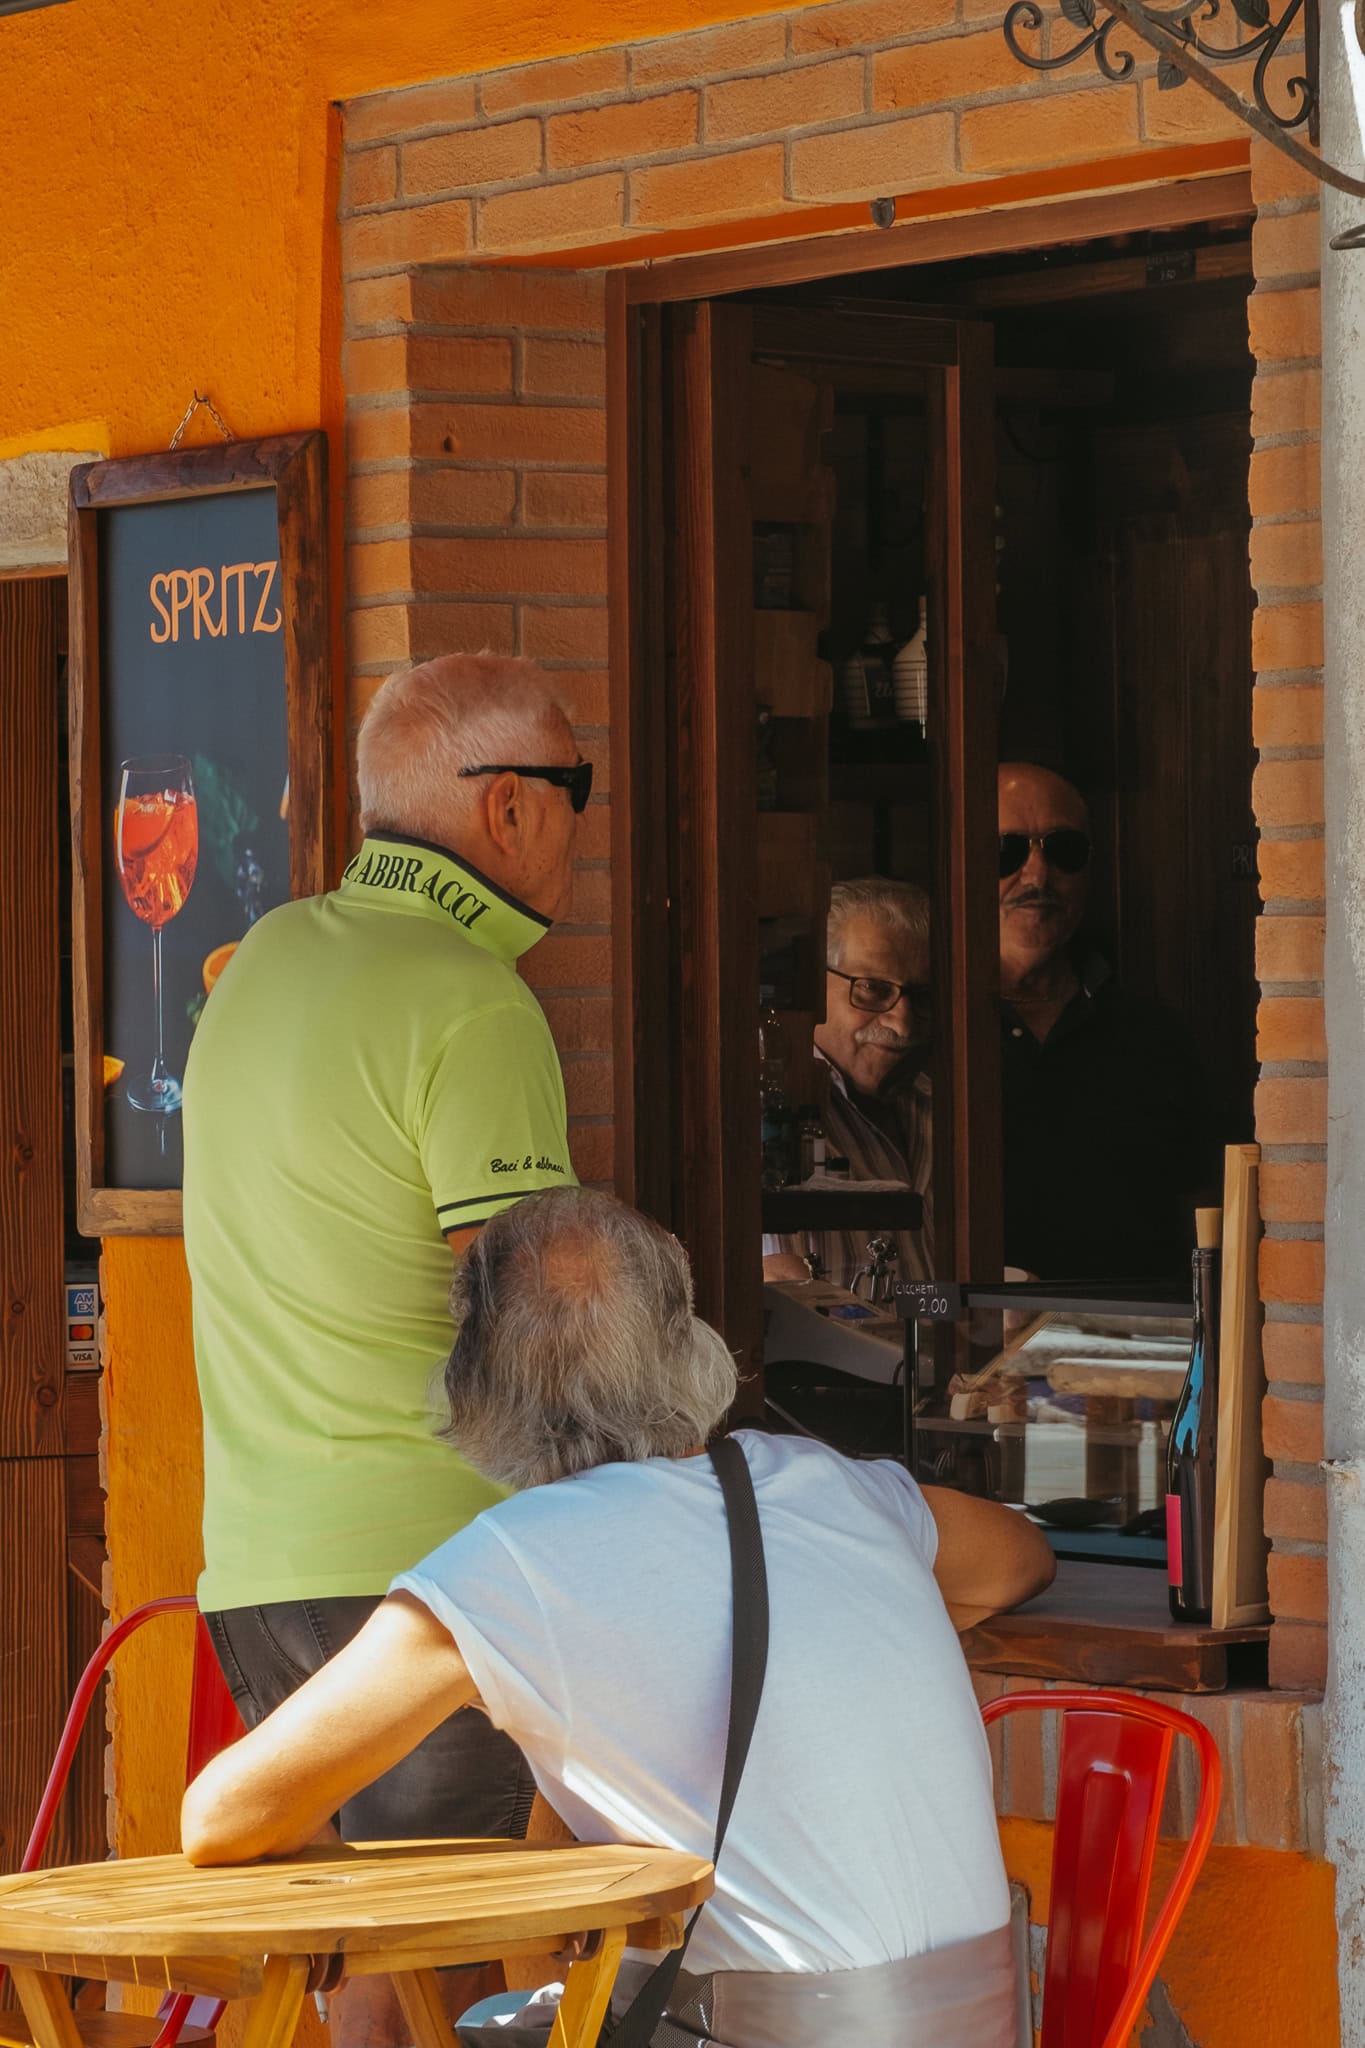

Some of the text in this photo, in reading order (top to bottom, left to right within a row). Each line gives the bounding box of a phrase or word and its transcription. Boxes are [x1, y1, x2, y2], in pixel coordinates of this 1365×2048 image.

[150, 561, 282, 644] SPRITZ
[353, 852, 491, 929] ABBRACCI
[490, 1158, 519, 1173] Baci
[522, 1155, 532, 1170] &
[74, 1293, 94, 1304] AM
[77, 1303, 94, 1313] EX
[73, 1353, 92, 1361] VISA
